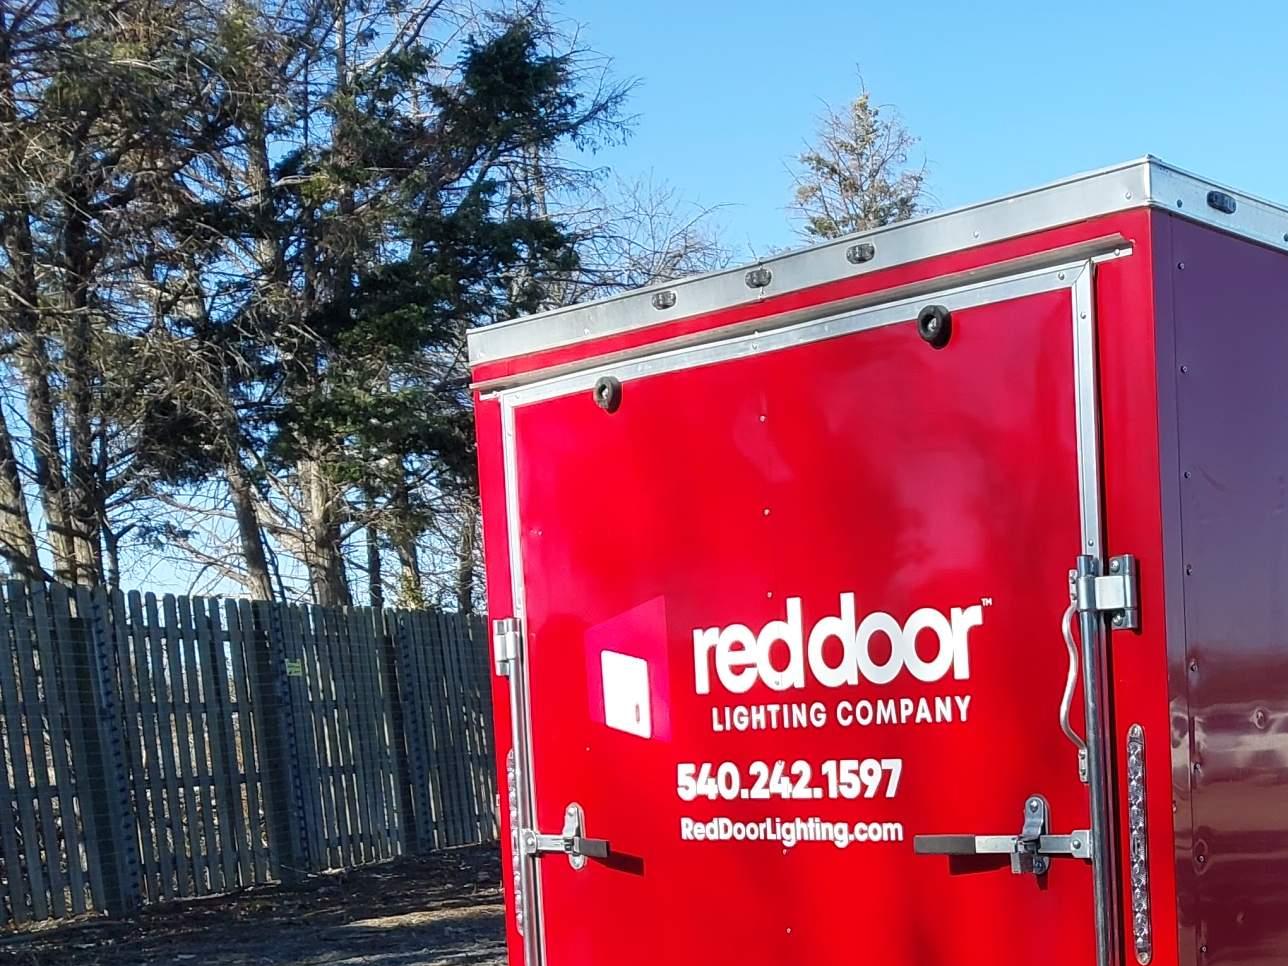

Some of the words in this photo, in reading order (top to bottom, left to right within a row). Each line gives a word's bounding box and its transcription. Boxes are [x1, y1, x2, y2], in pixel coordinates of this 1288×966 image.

[712, 703, 827, 731] LIGHTING
[837, 696, 971, 726] COMPANY
[677, 759, 902, 800] 540.242.1597
[681, 817, 903, 847] RedDoorLighting.com
